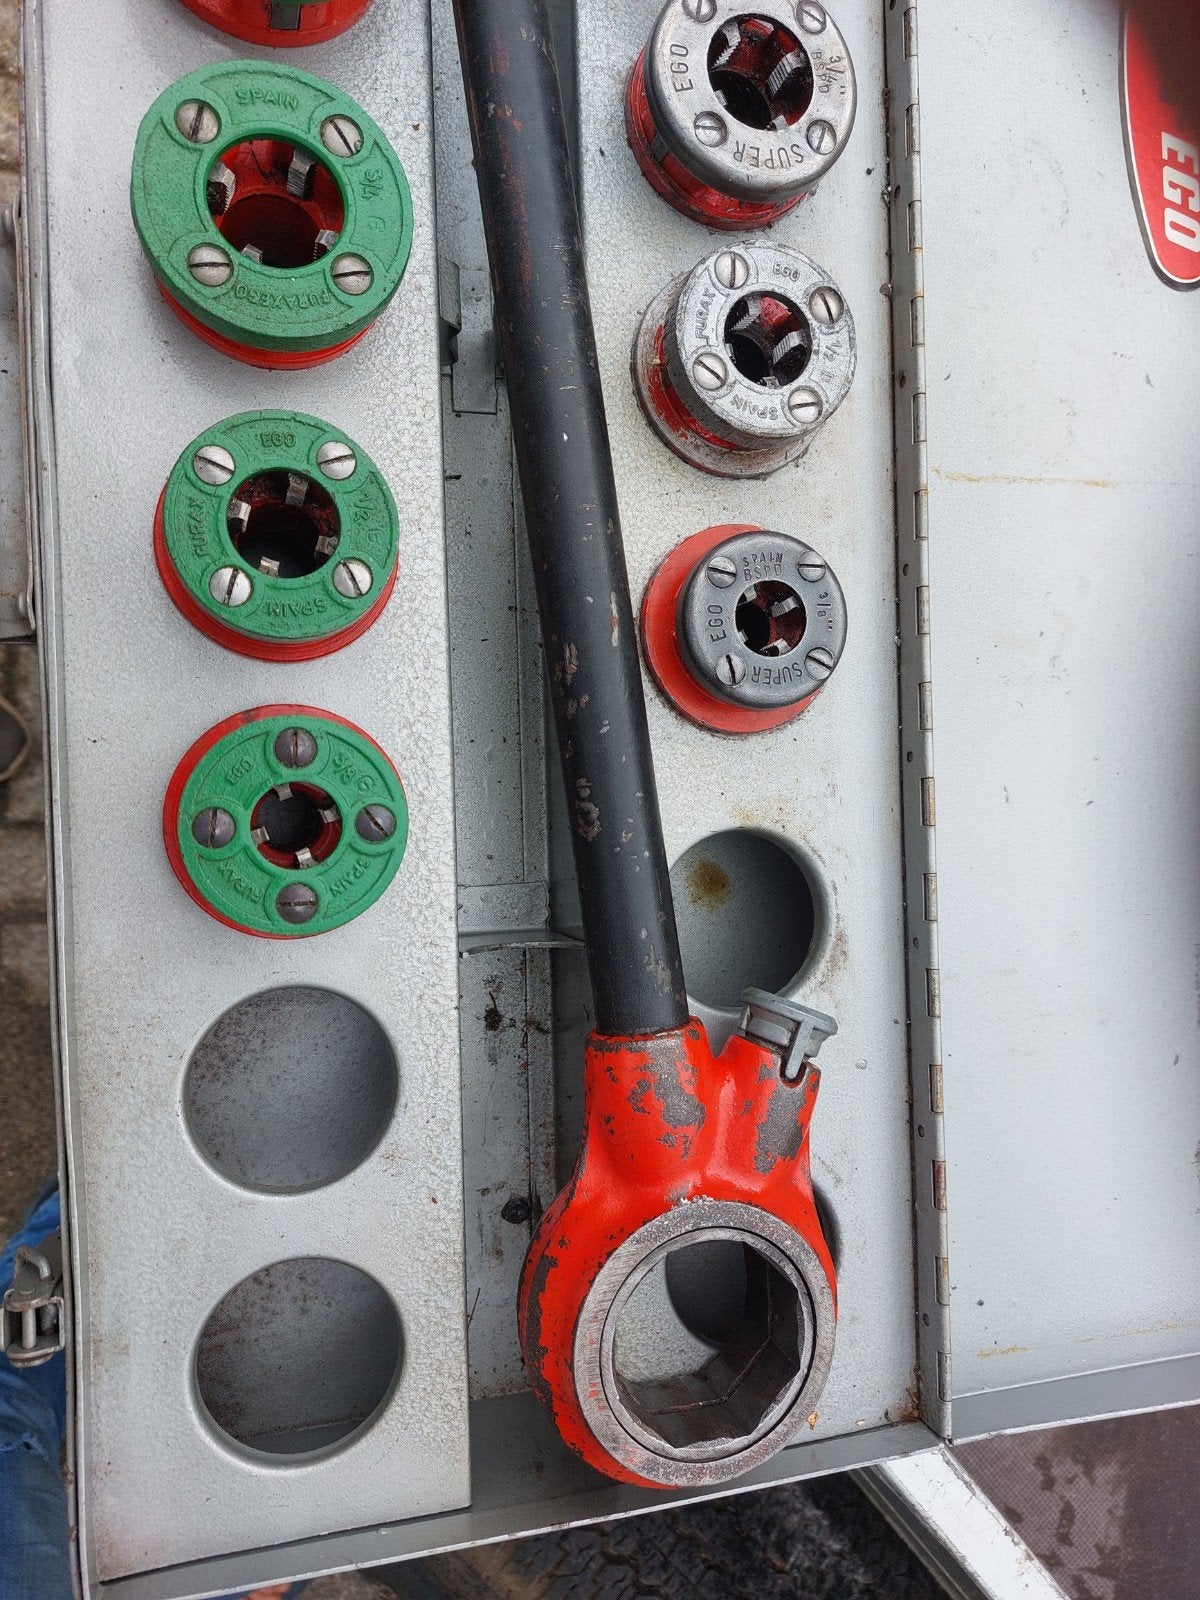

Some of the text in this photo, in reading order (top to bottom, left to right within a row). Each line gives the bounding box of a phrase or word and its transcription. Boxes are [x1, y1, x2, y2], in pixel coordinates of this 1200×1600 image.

[670, 43, 694, 93] EGO
[811, 51, 830, 94] BSPD
[236, 89, 299, 111] SPAIN
[733, 140, 804, 170] SUPER
[1161, 131, 1200, 253] EGO
[772, 260, 801, 282] EGO
[730, 393, 779, 421] SPAIN
[259, 430, 297, 448] EGO
[742, 552, 784, 568] SPAIN
[743, 563, 783, 582] BSPD
[267, 598, 328, 617] SPAIN
[707, 604, 727, 643] EGO
[751, 661, 803, 685] SUPER
[329, 856, 371, 898] SPAIN
